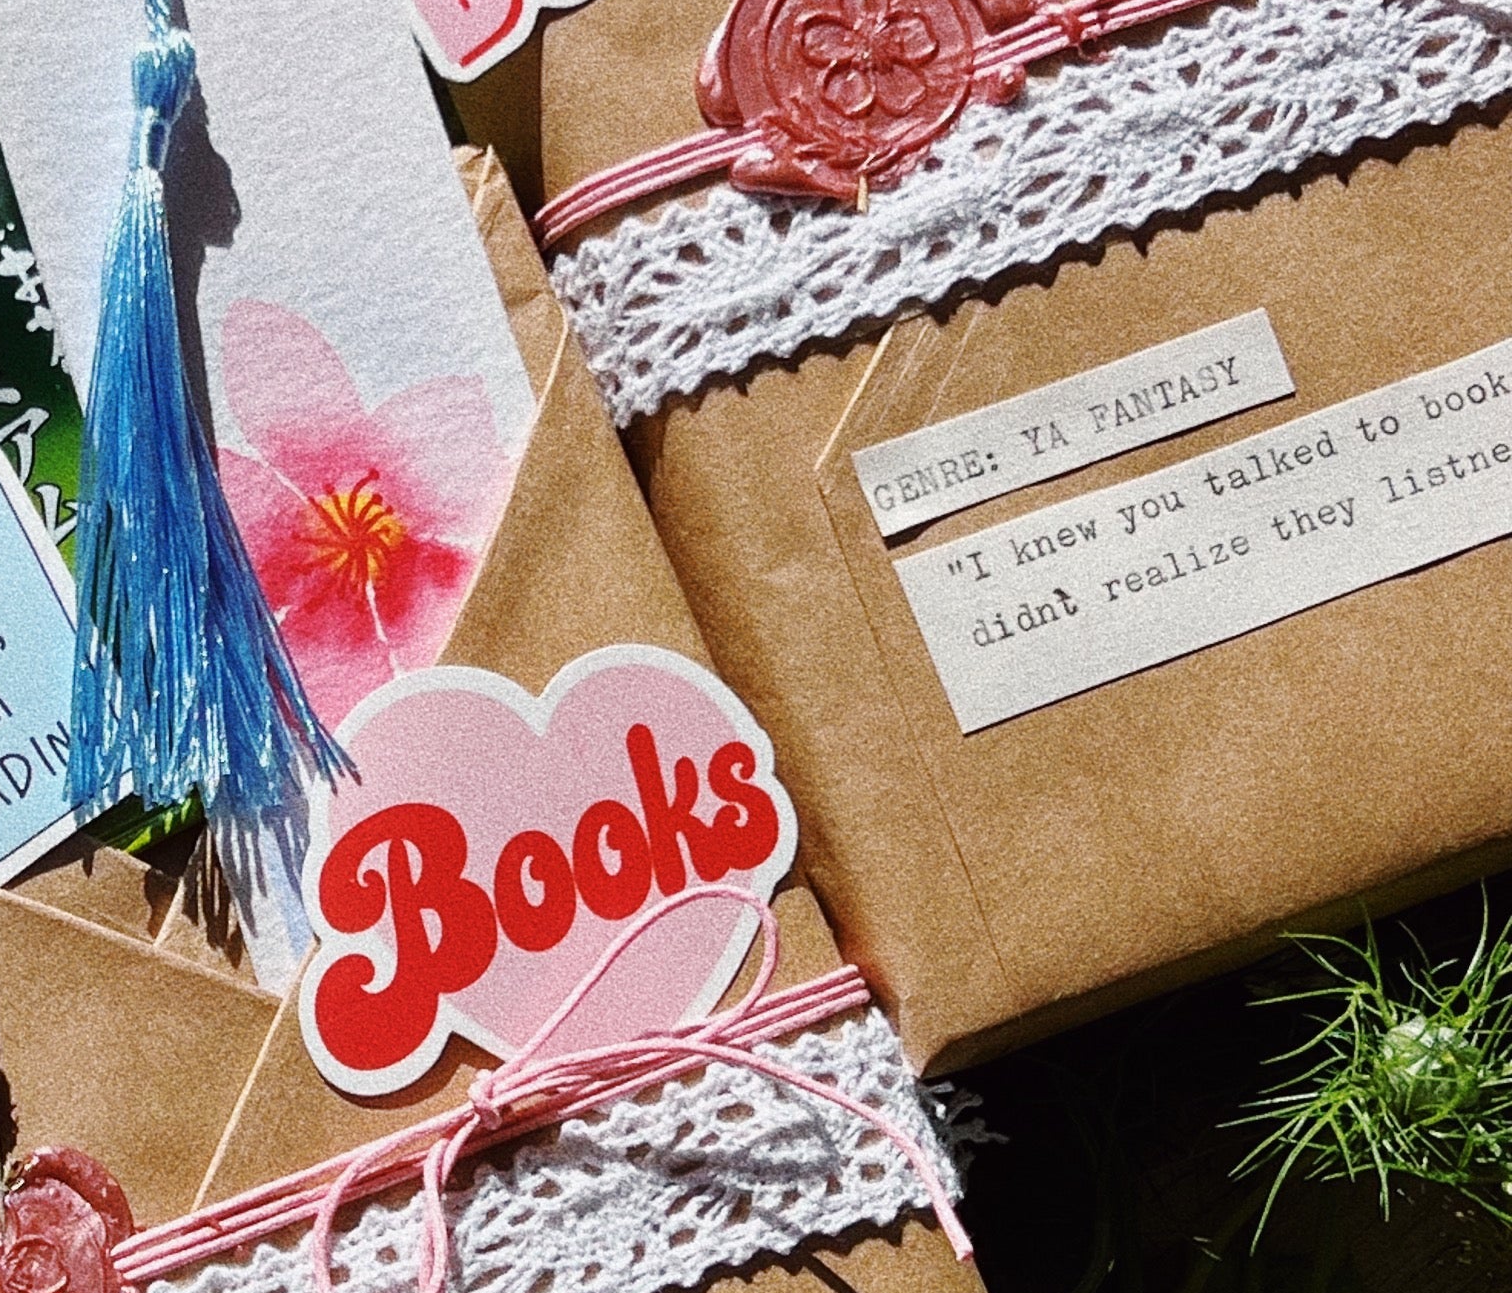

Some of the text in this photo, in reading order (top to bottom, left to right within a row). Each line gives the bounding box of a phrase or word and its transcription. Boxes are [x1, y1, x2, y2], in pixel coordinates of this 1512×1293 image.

[872, 355, 1241, 511] GENRE: YA FANTASY
[947, 549, 992, 582] "I
[1009, 518, 1098, 567] knew
[1117, 491, 1186, 536] you
[1204, 430, 1339, 497] talked
[1356, 416, 1400, 443] to
[1102, 532, 1252, 603] realize
[1270, 496, 1355, 543] they
[314, 722, 780, 1071] Books
